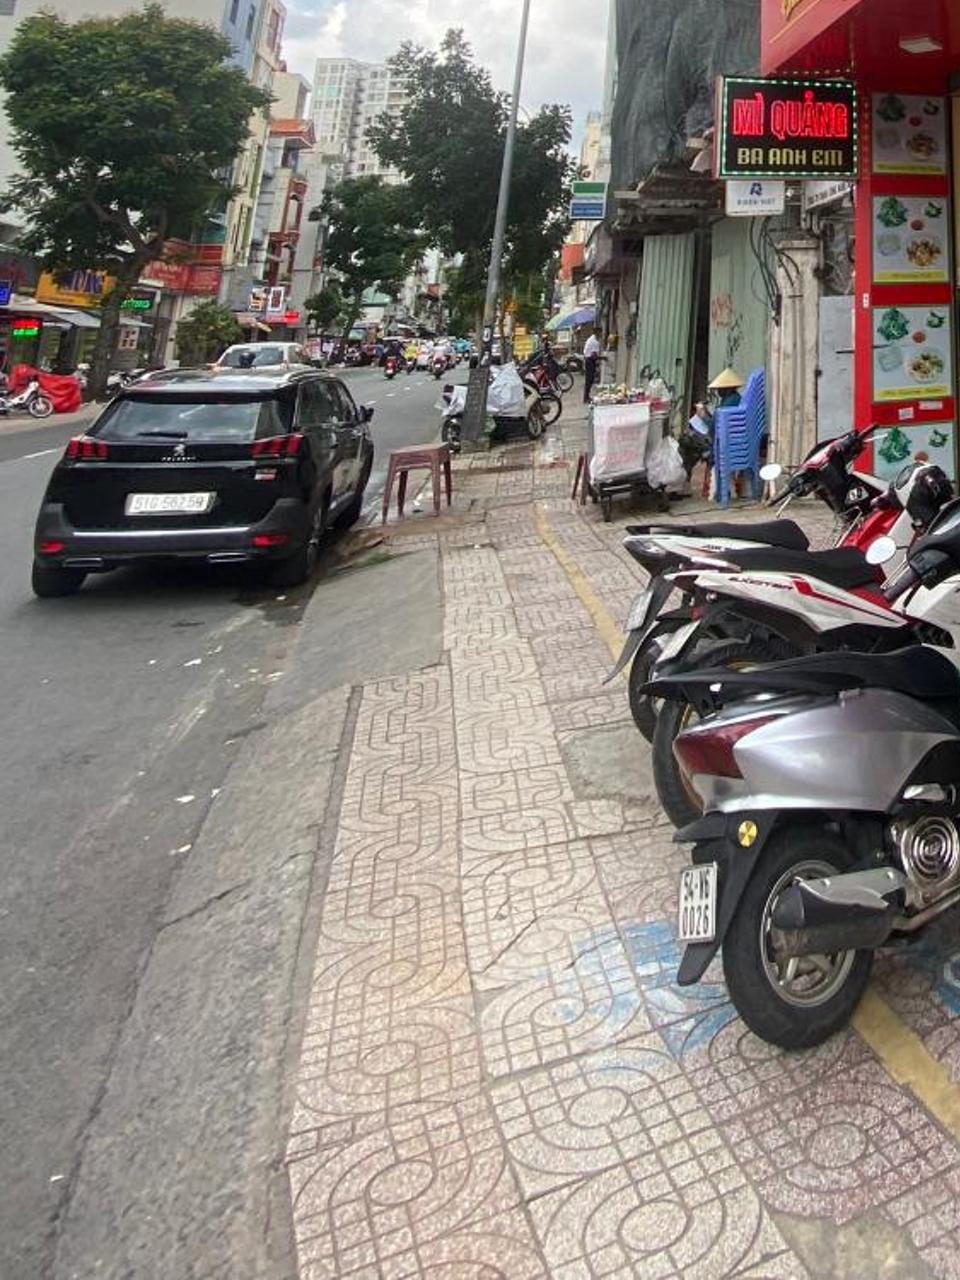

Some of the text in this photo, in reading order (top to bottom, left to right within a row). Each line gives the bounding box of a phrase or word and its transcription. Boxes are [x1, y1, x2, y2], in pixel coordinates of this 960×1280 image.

[733, 90, 849, 140] MÌ QUẢNG
[737, 147, 843, 166] BA ANH EM
